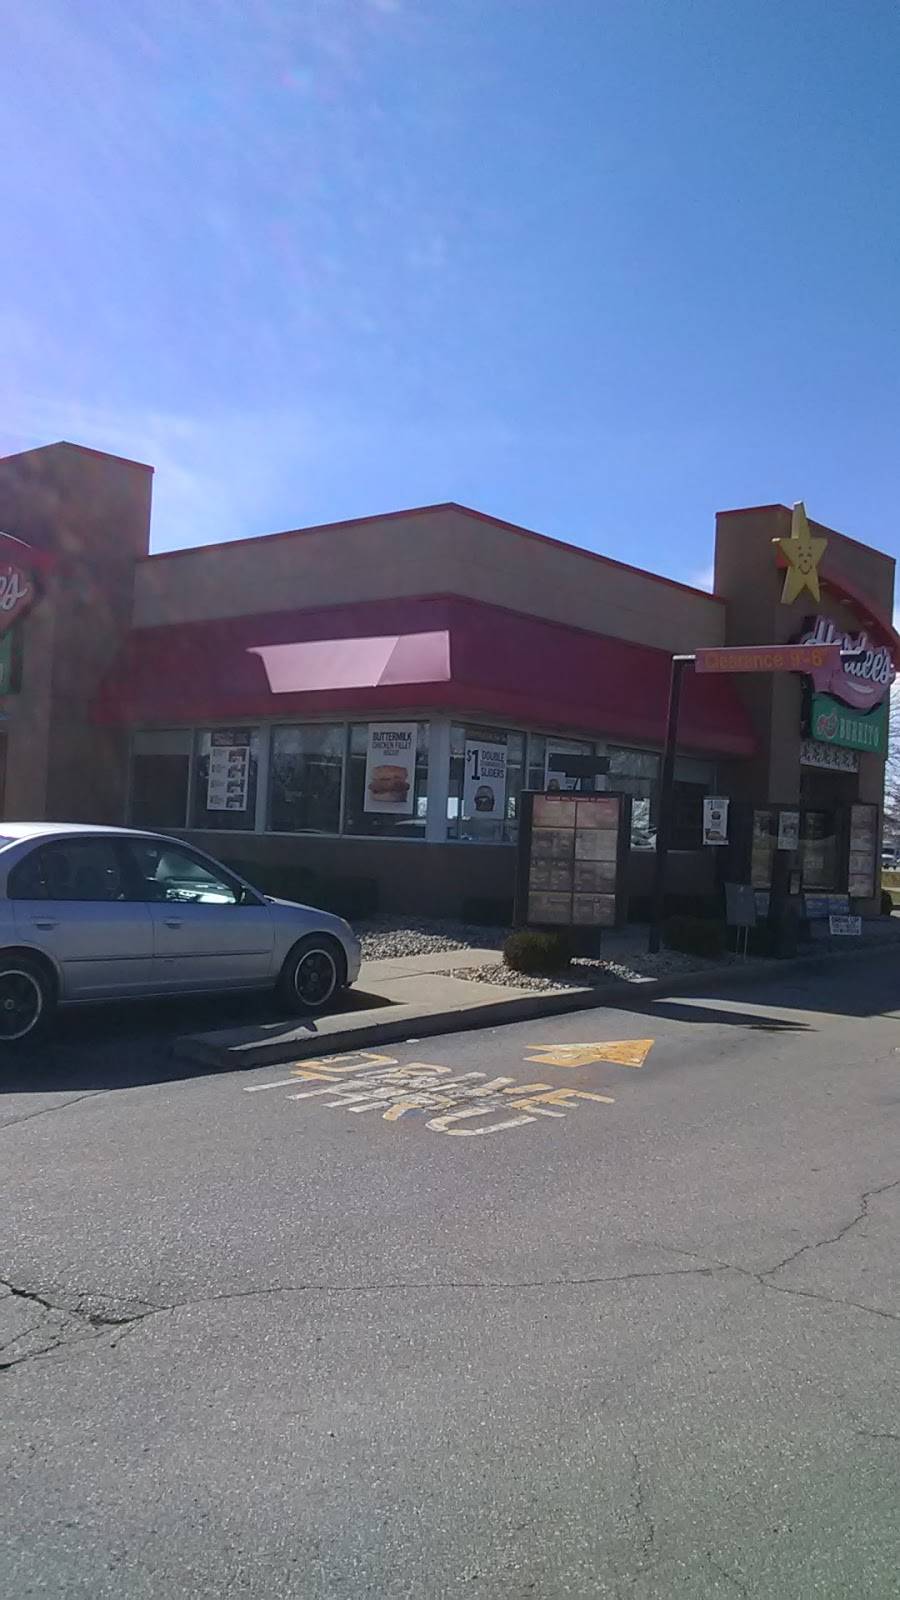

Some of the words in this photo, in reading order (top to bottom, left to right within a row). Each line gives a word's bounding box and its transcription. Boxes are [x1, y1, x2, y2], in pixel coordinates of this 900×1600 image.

[704, 651, 784, 669] Clearance
[839, 717, 880, 747] BURRITO
[466, 749, 481, 781] $1
[481, 750, 505, 762] DOUBLE
[481, 767, 505, 779] SLIDERS
